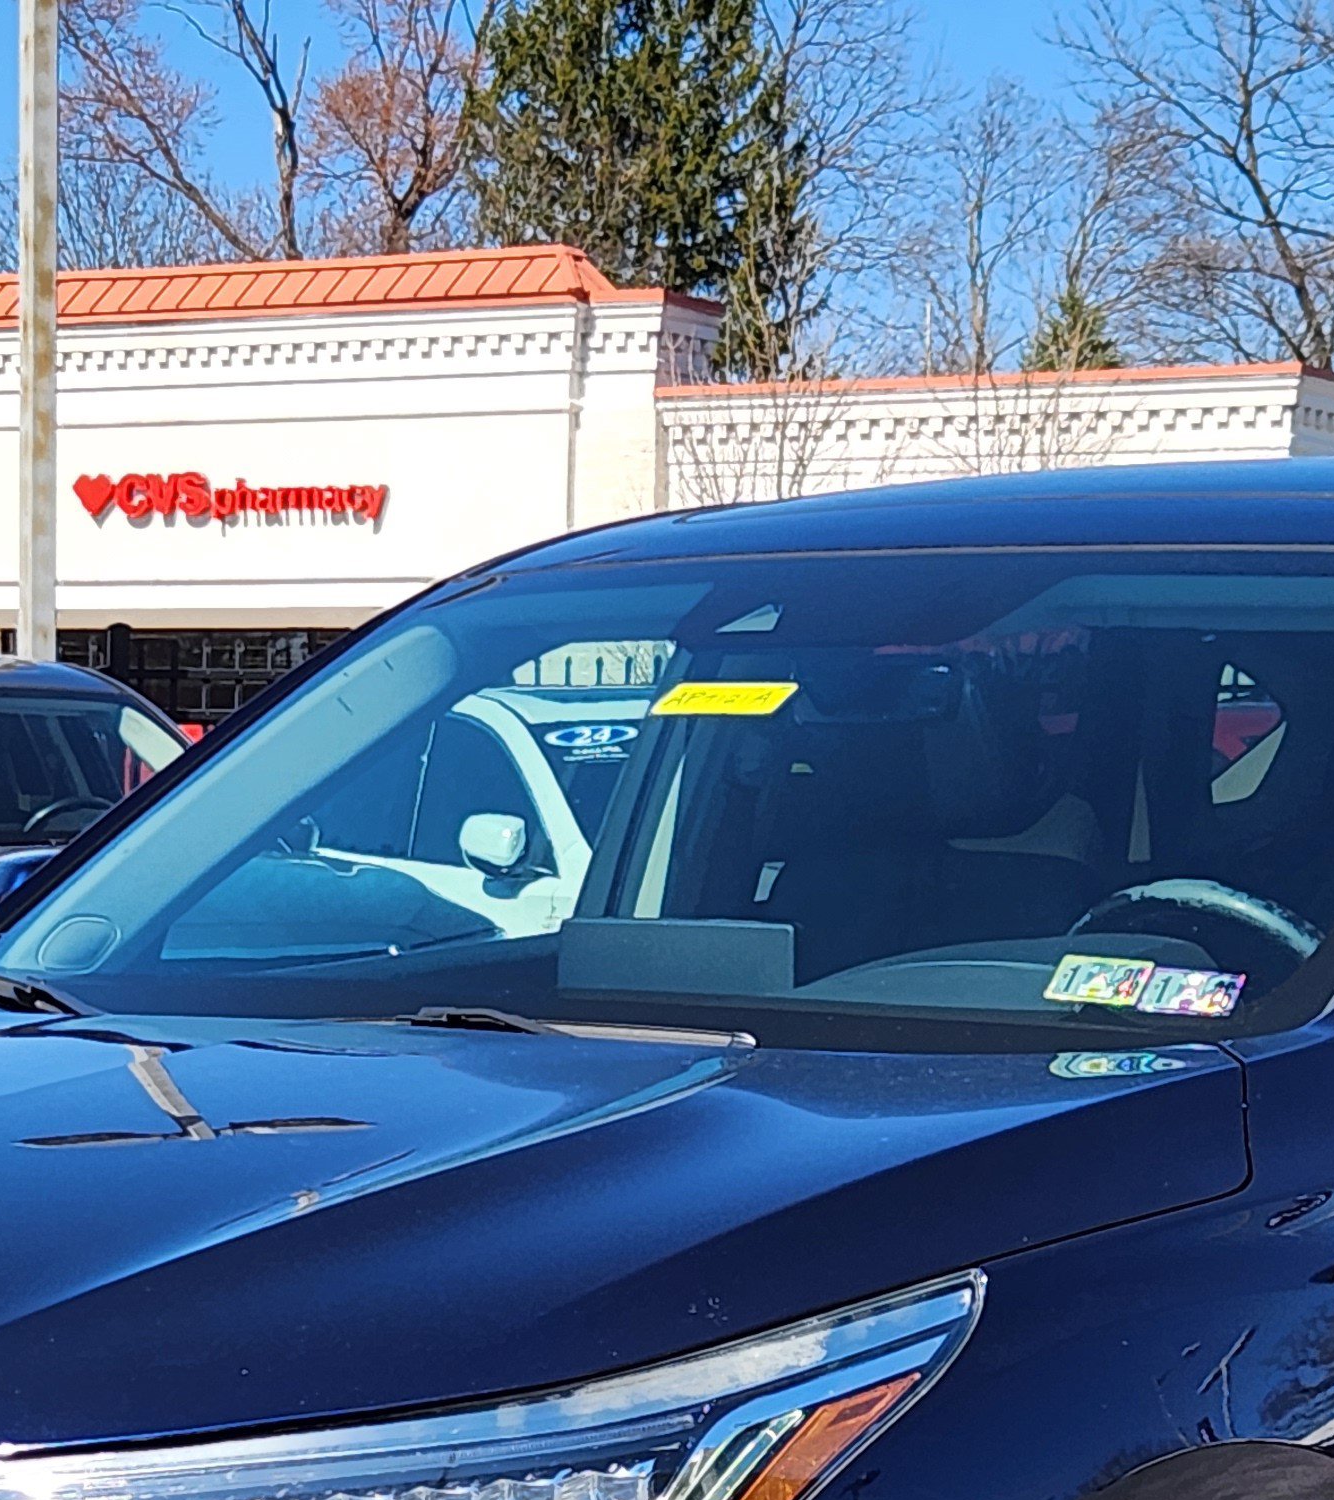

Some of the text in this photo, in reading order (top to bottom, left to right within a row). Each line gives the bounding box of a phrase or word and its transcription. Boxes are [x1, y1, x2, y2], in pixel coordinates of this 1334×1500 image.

[117, 472, 387, 524] CVS pharmacy
[571, 726, 612, 745] 24
